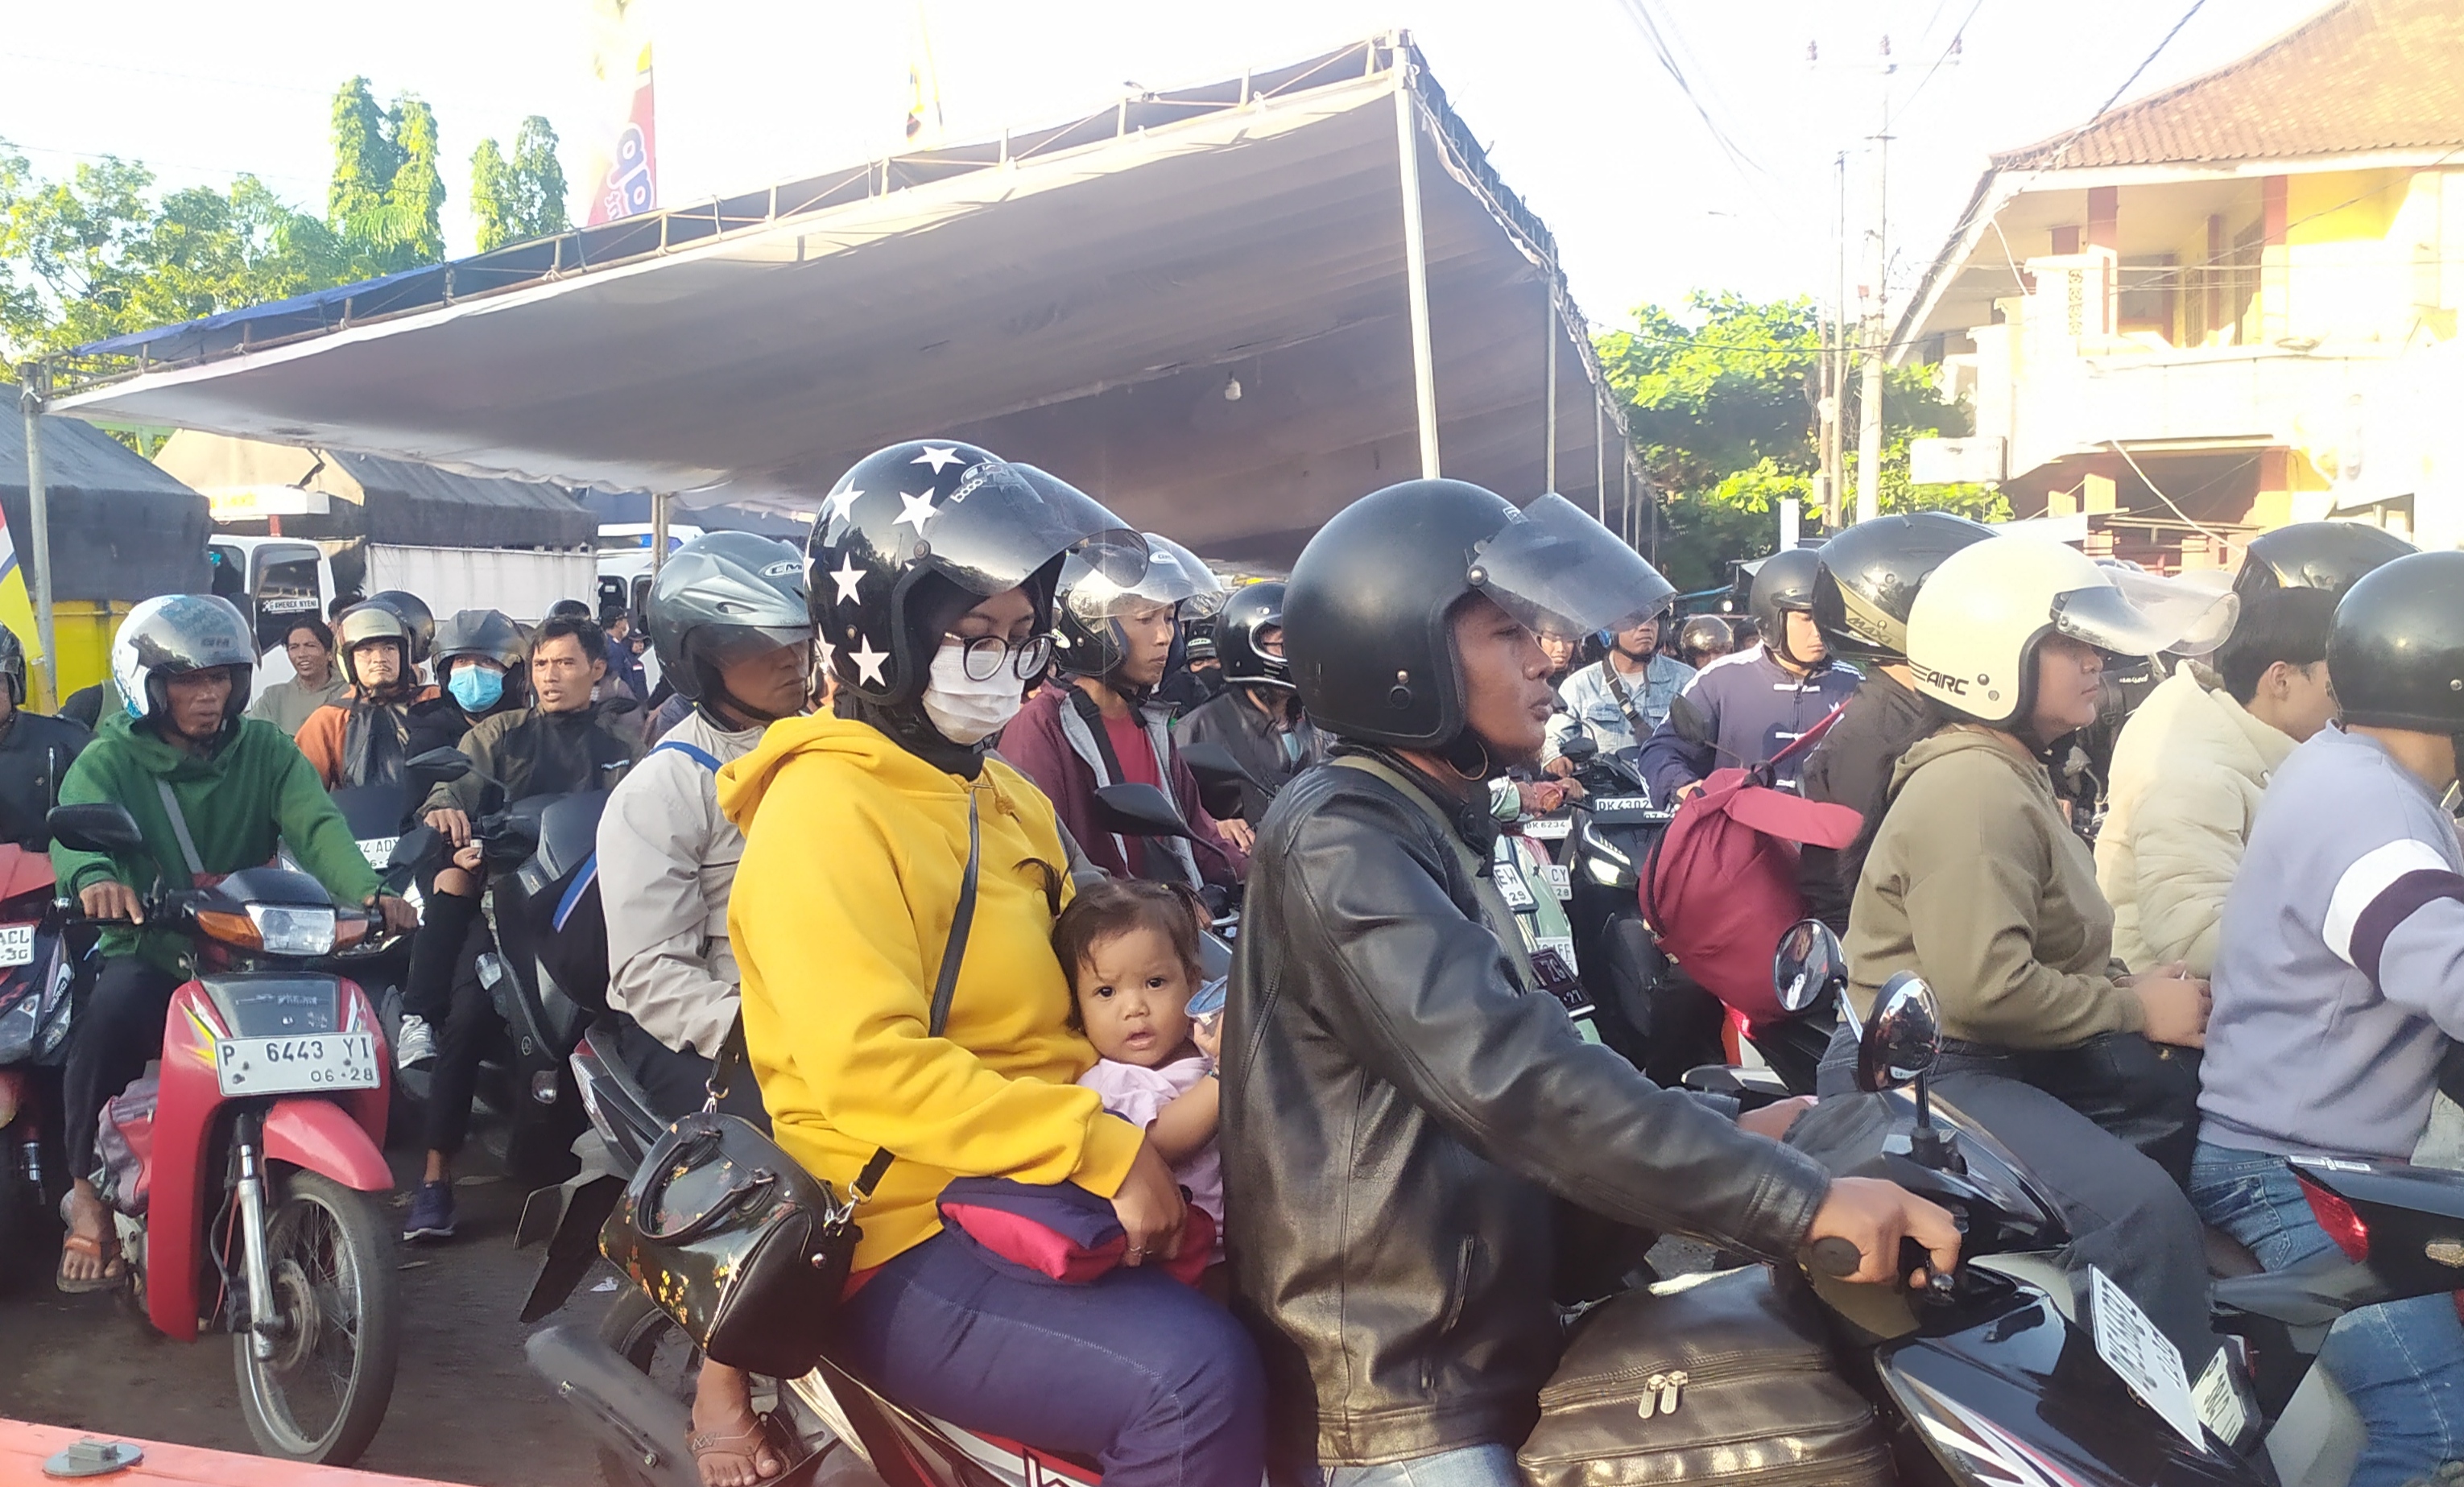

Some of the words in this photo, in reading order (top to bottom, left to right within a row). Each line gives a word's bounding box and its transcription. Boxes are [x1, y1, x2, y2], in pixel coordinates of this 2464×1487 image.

[1551, 868, 1567, 882] CY
[44, 980, 68, 1013] VARIO
[221, 1044, 236, 1067] P
[266, 1040, 325, 1063] 6443
[342, 1036, 369, 1059] YI
